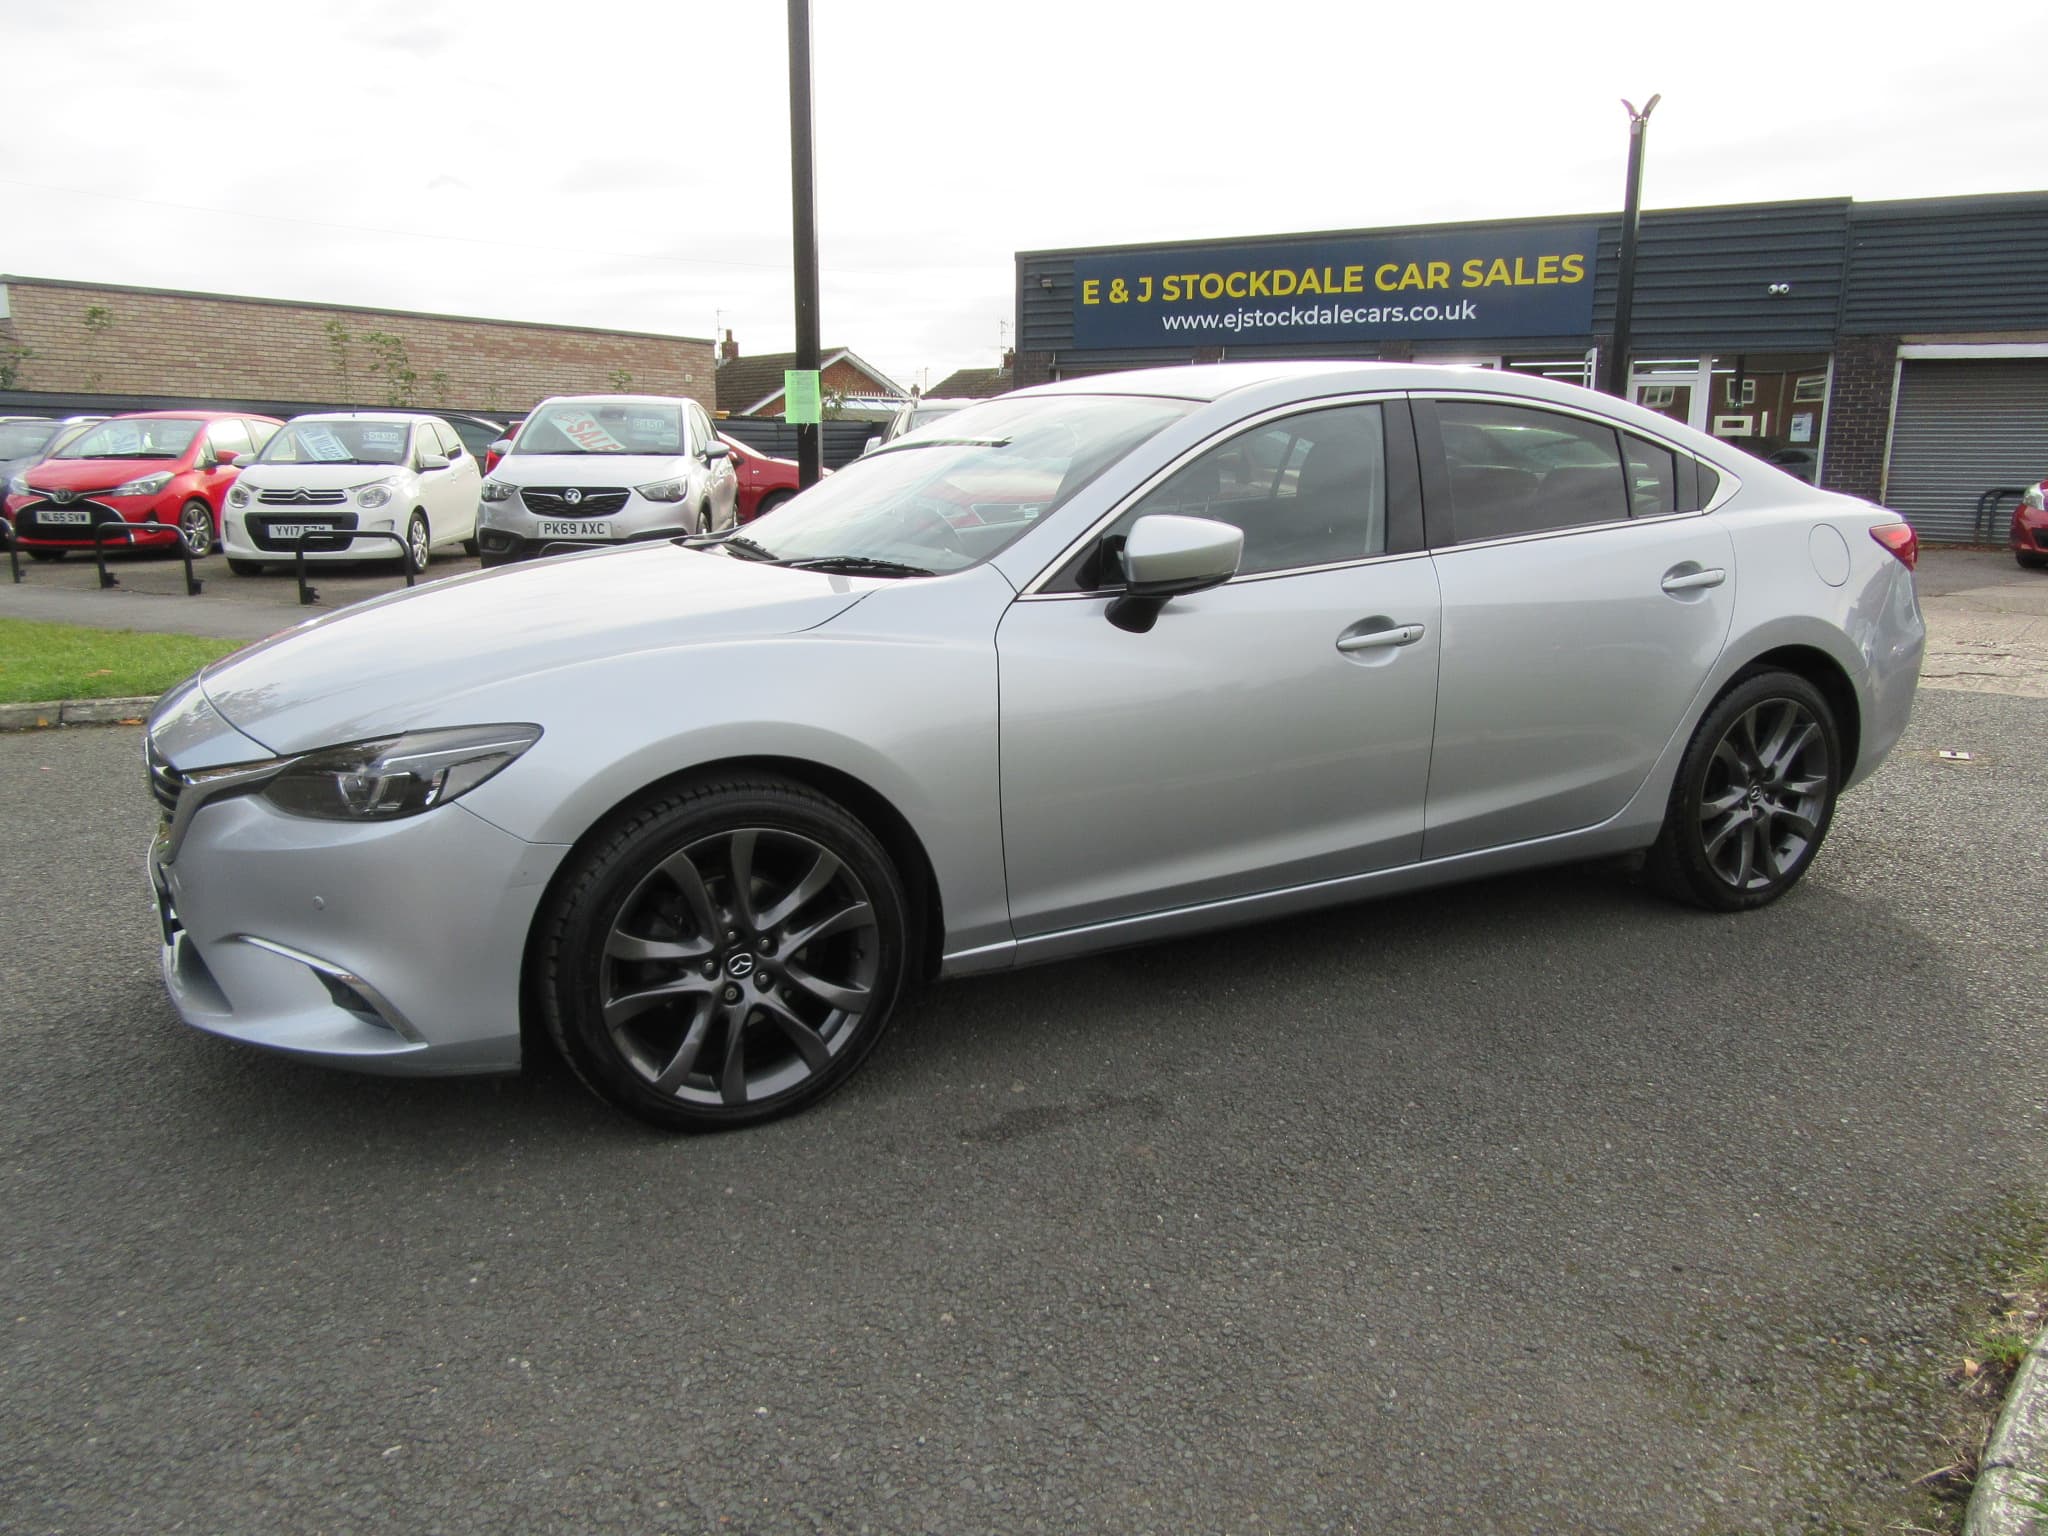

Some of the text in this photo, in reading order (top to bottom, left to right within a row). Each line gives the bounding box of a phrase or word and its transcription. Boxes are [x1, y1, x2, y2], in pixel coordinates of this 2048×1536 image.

[1083, 253, 1585, 305] E & J STOCKDALE CAR SALES
[1162, 299, 1476, 332] www.ejstockdalecars.co.uk
[275, 525, 300, 536] YY17
[543, 523, 605, 535] PK69 AXC
